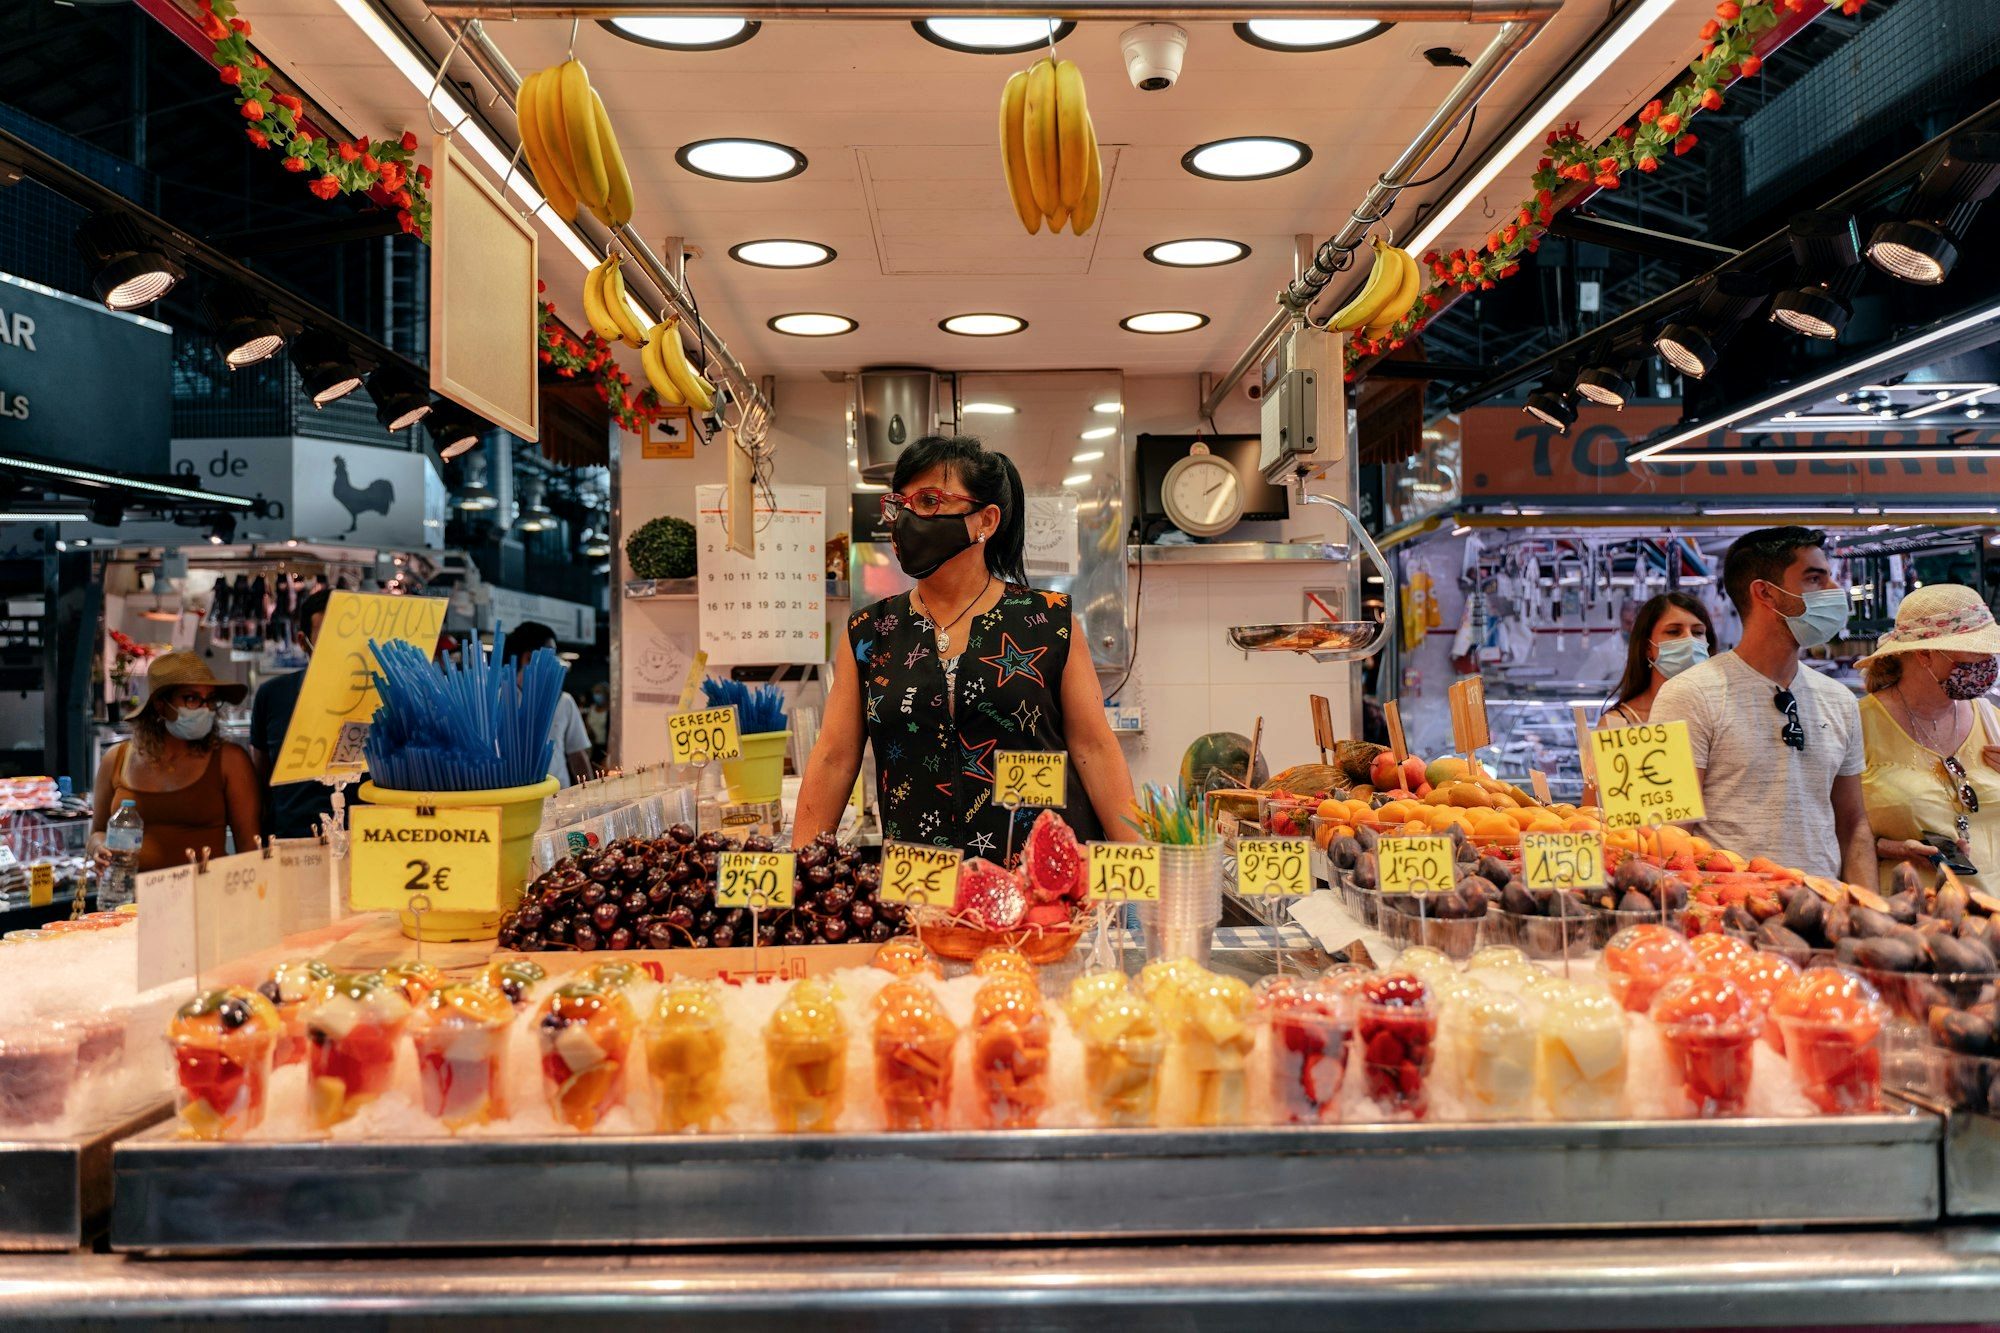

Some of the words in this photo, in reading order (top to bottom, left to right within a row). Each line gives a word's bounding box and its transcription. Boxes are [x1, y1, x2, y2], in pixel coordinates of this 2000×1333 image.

[209, 449, 249, 478] de
[708, 544, 714, 552] 2
[760, 543, 766, 551] 5
[793, 544, 799, 552] 7
[708, 574, 714, 582] 9
[724, 573, 734, 581] 10
[741, 572, 750, 580] 11
[758, 572, 768, 580] 12
[775, 572, 786, 580] 13
[792, 572, 802, 580] 14
[808, 574, 818, 582] 15
[707, 602, 718, 611] 16
[724, 602, 735, 610] 17
[741, 602, 752, 610] 18
[758, 601, 769, 609] 19
[774, 600, 786, 609] 20
[792, 601, 802, 609] 21
[808, 602, 818, 610] 22
[1023, 612, 1049, 628] STAR
[741, 631, 752, 640] 25
[758, 630, 769, 639] 26
[775, 630, 787, 638] 27
[792, 630, 804, 638] 28
[809, 631, 819, 640] 29
[900, 686, 918, 715] STAR
[669, 709, 731, 729] CEREZAS
[1598, 723, 1668, 752] HIGOS
[712, 749, 739, 761] KILO
[998, 753, 1062, 765] PITAHAYA
[1640, 790, 1674, 807] FIGS
[1665, 807, 1692, 821] BOX
[363, 828, 491, 843] MACEDONIA
[1239, 841, 1305, 854] FRESAS
[885, 844, 958, 869] PAPAYAS
